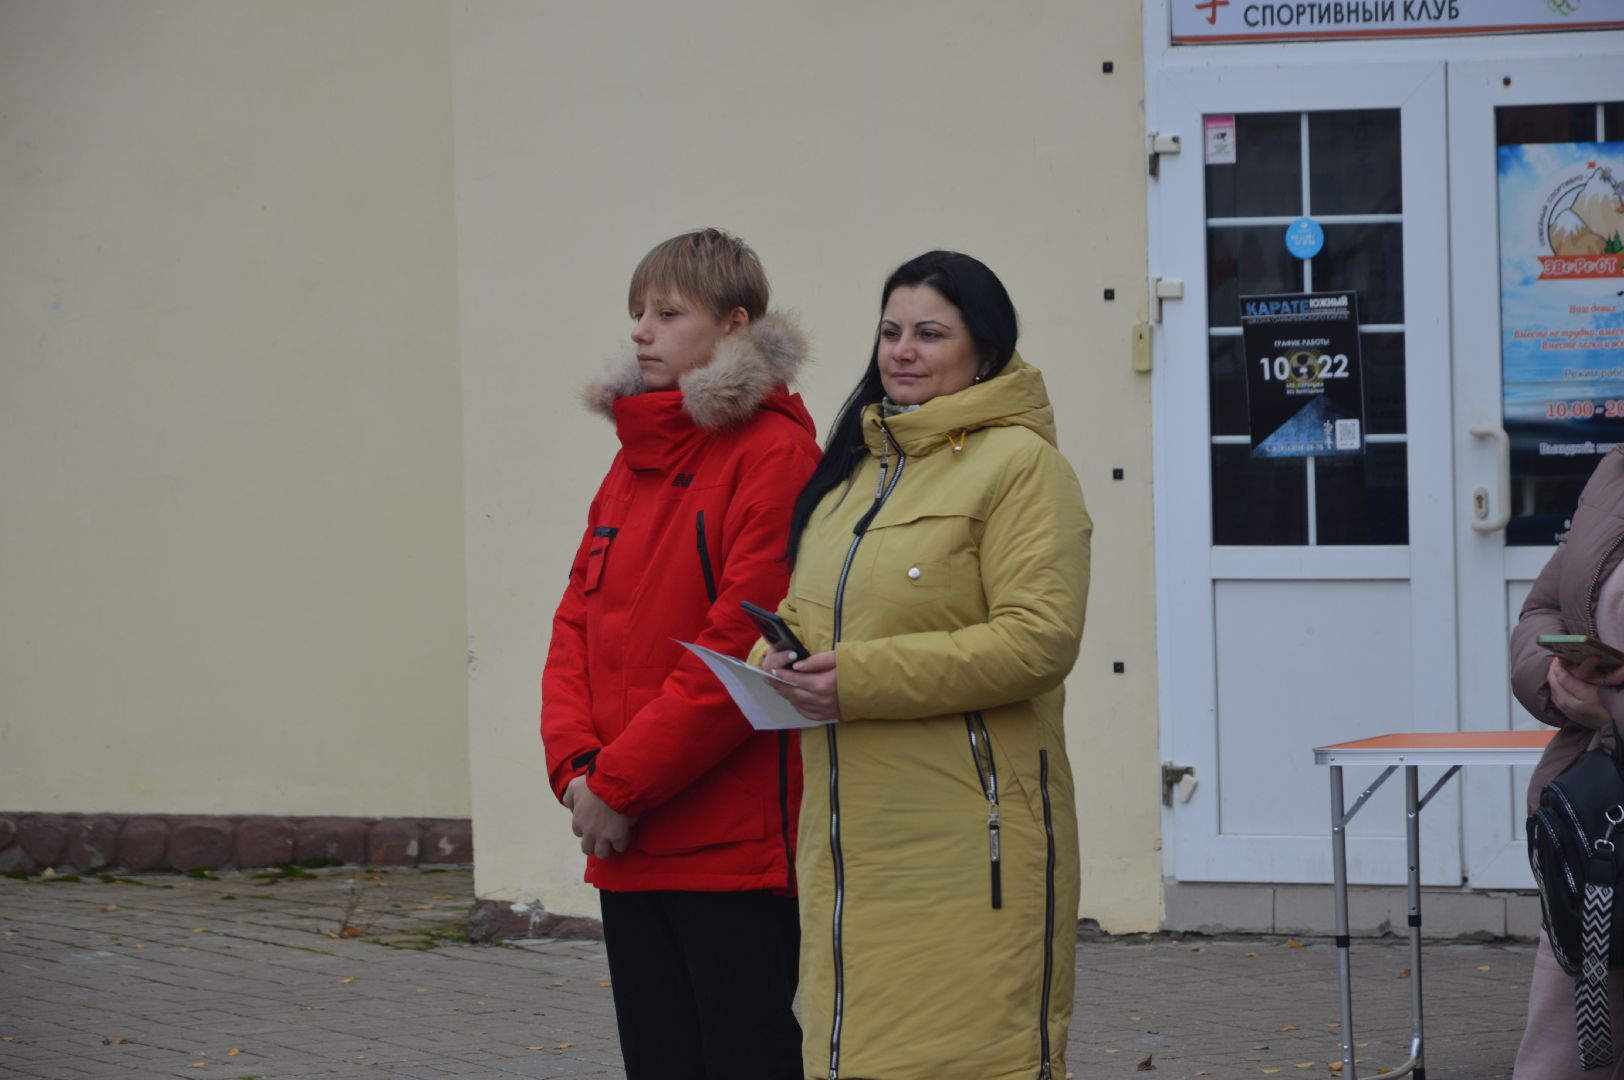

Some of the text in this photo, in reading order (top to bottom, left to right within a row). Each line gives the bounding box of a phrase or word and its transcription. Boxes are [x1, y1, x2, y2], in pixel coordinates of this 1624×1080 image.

[1404, 0, 1459, 21] КЛУБ
[1246, 300, 1309, 316] КАРАТЕ
[1309, 295, 1348, 308] ЮЖНЫЙ
[1274, 338, 1329, 347] ГРАФИК РАБОТЫ
[1260, 356, 1290, 381] 10
[1317, 354, 1349, 378] 22
[1547, 400, 1594, 418] 10.00
